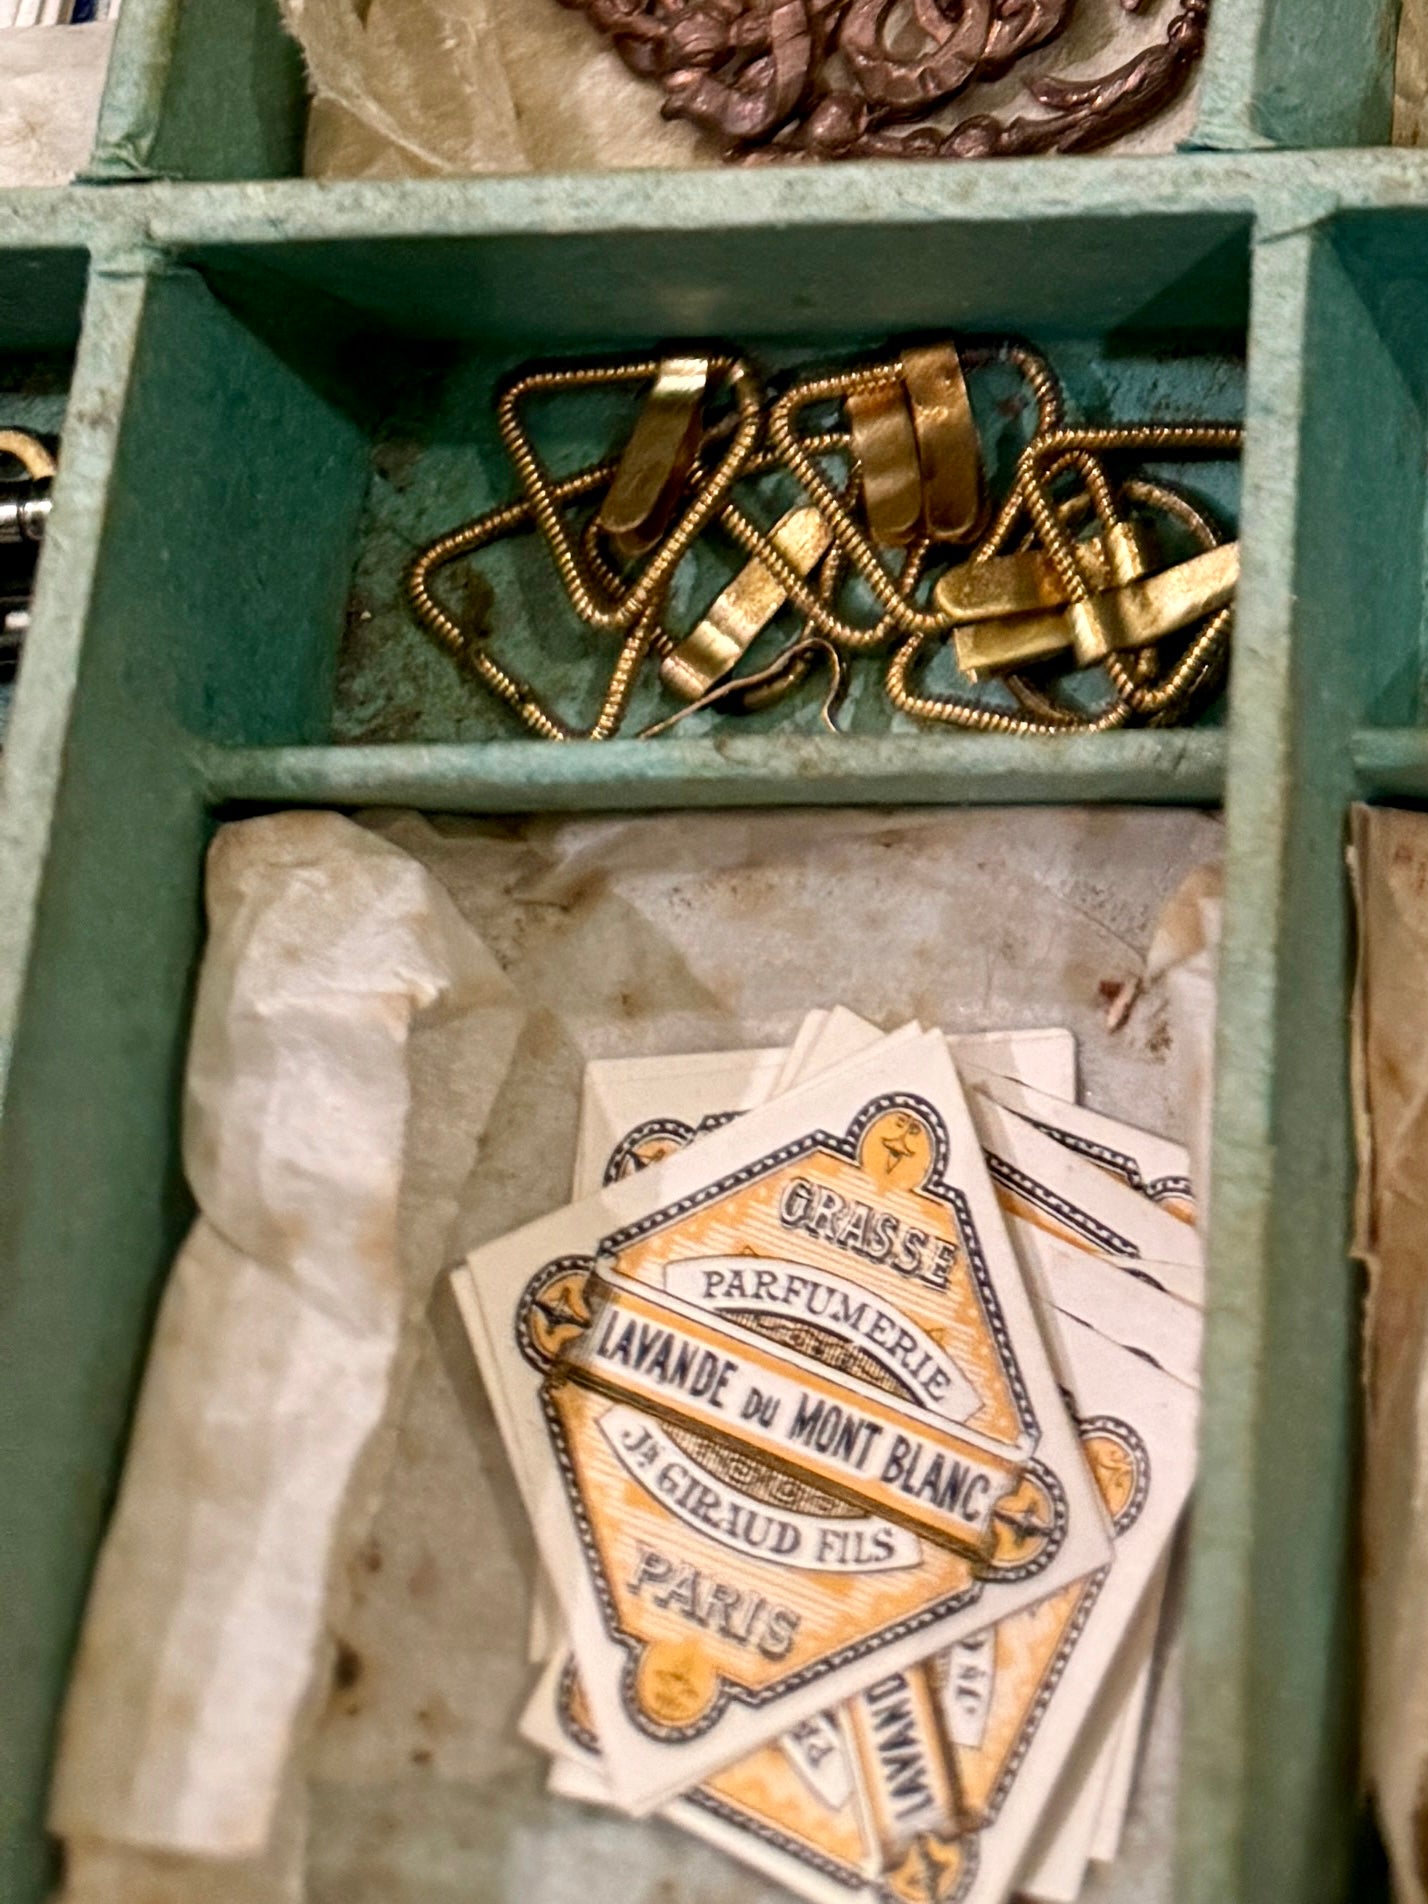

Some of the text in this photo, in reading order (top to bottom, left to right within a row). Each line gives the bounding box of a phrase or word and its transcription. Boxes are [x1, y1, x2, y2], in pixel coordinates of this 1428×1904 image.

[779, 1176, 959, 1292] GRASSE
[703, 1269, 954, 1403] PARFUMERIE
[597, 1310, 993, 1524] LAVANDE DU MONT BLANC
[657, 1466, 800, 1555] GIRAUD
[816, 1527, 897, 1566] FILS
[625, 1542, 801, 1663] PARIS
